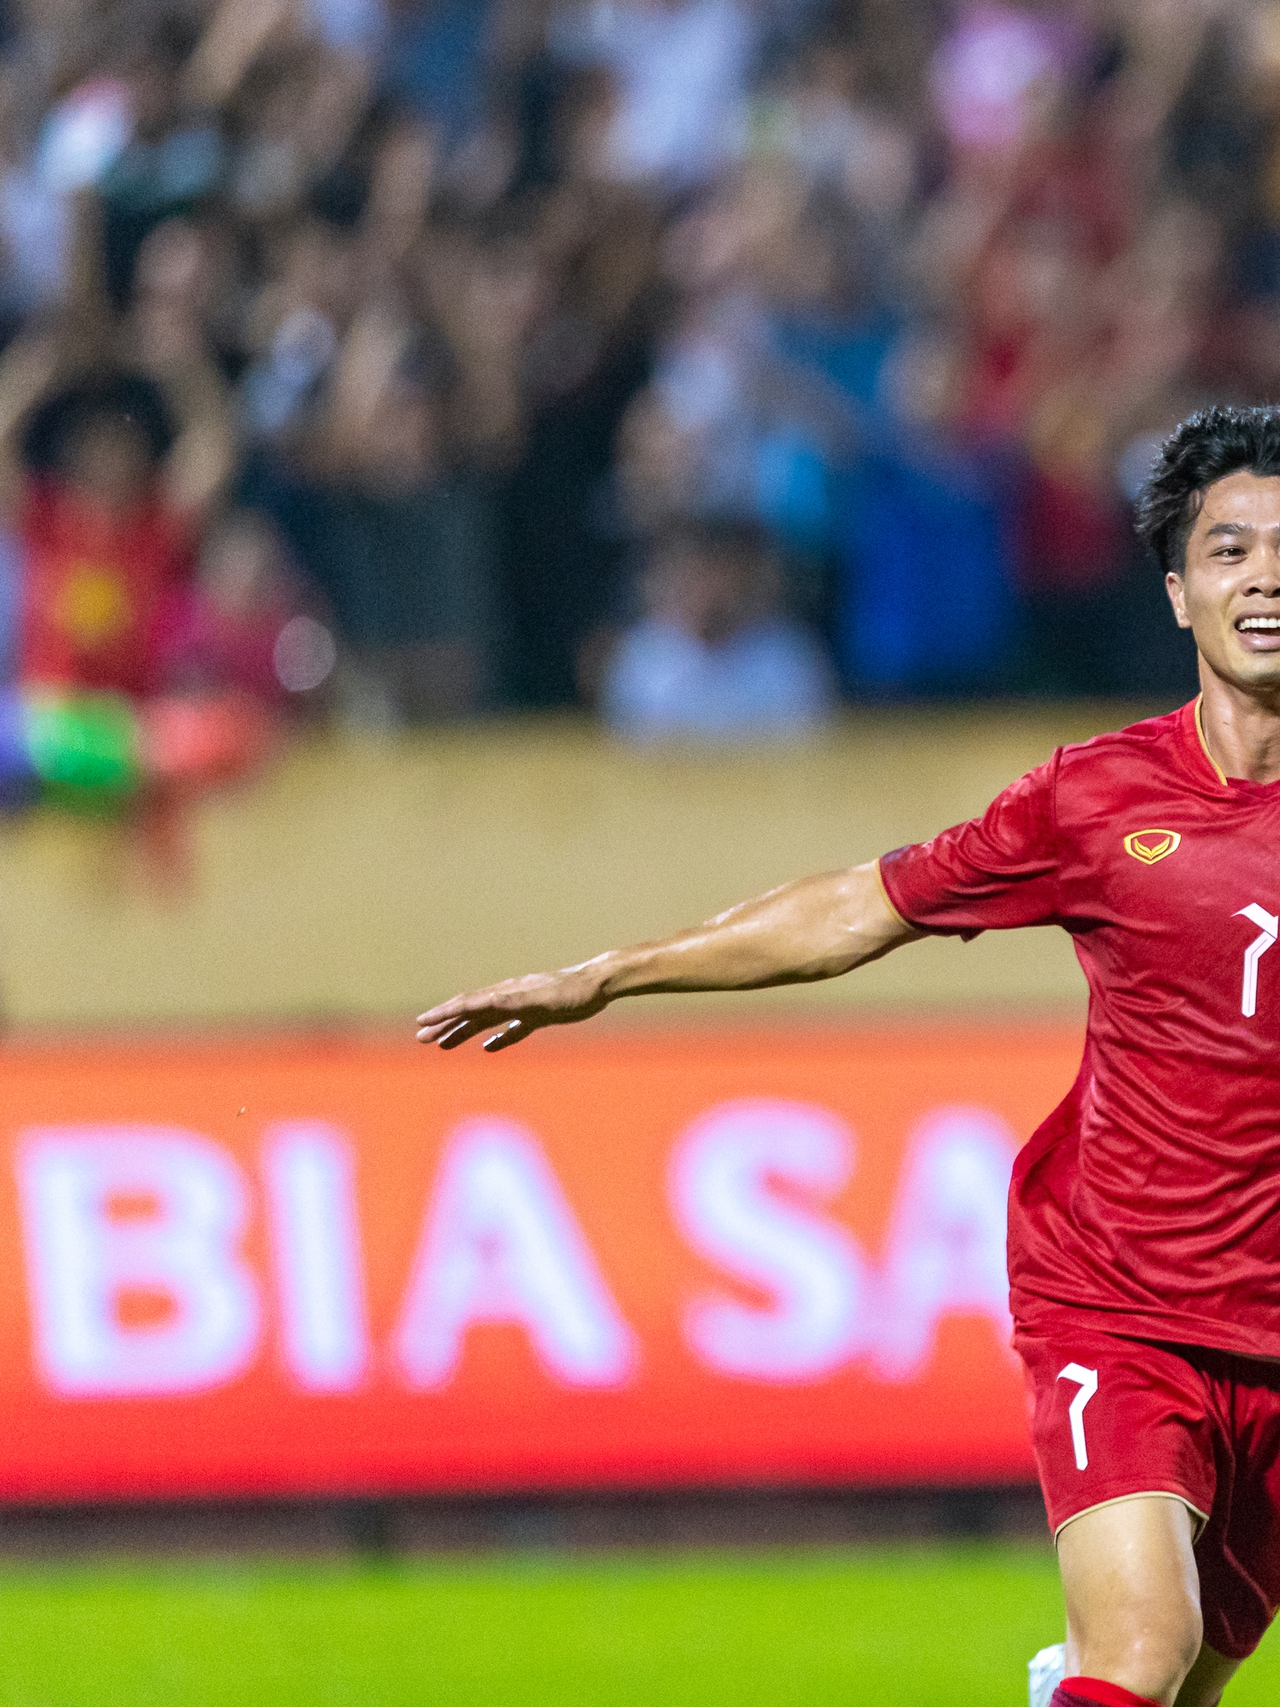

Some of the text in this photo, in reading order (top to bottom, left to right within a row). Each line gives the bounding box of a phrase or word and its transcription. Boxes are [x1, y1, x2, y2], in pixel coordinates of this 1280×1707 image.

[1230, 902, 1279, 1018] 7
[18, 1116, 636, 1395] BIA
[1057, 1362, 1098, 1470] 7
